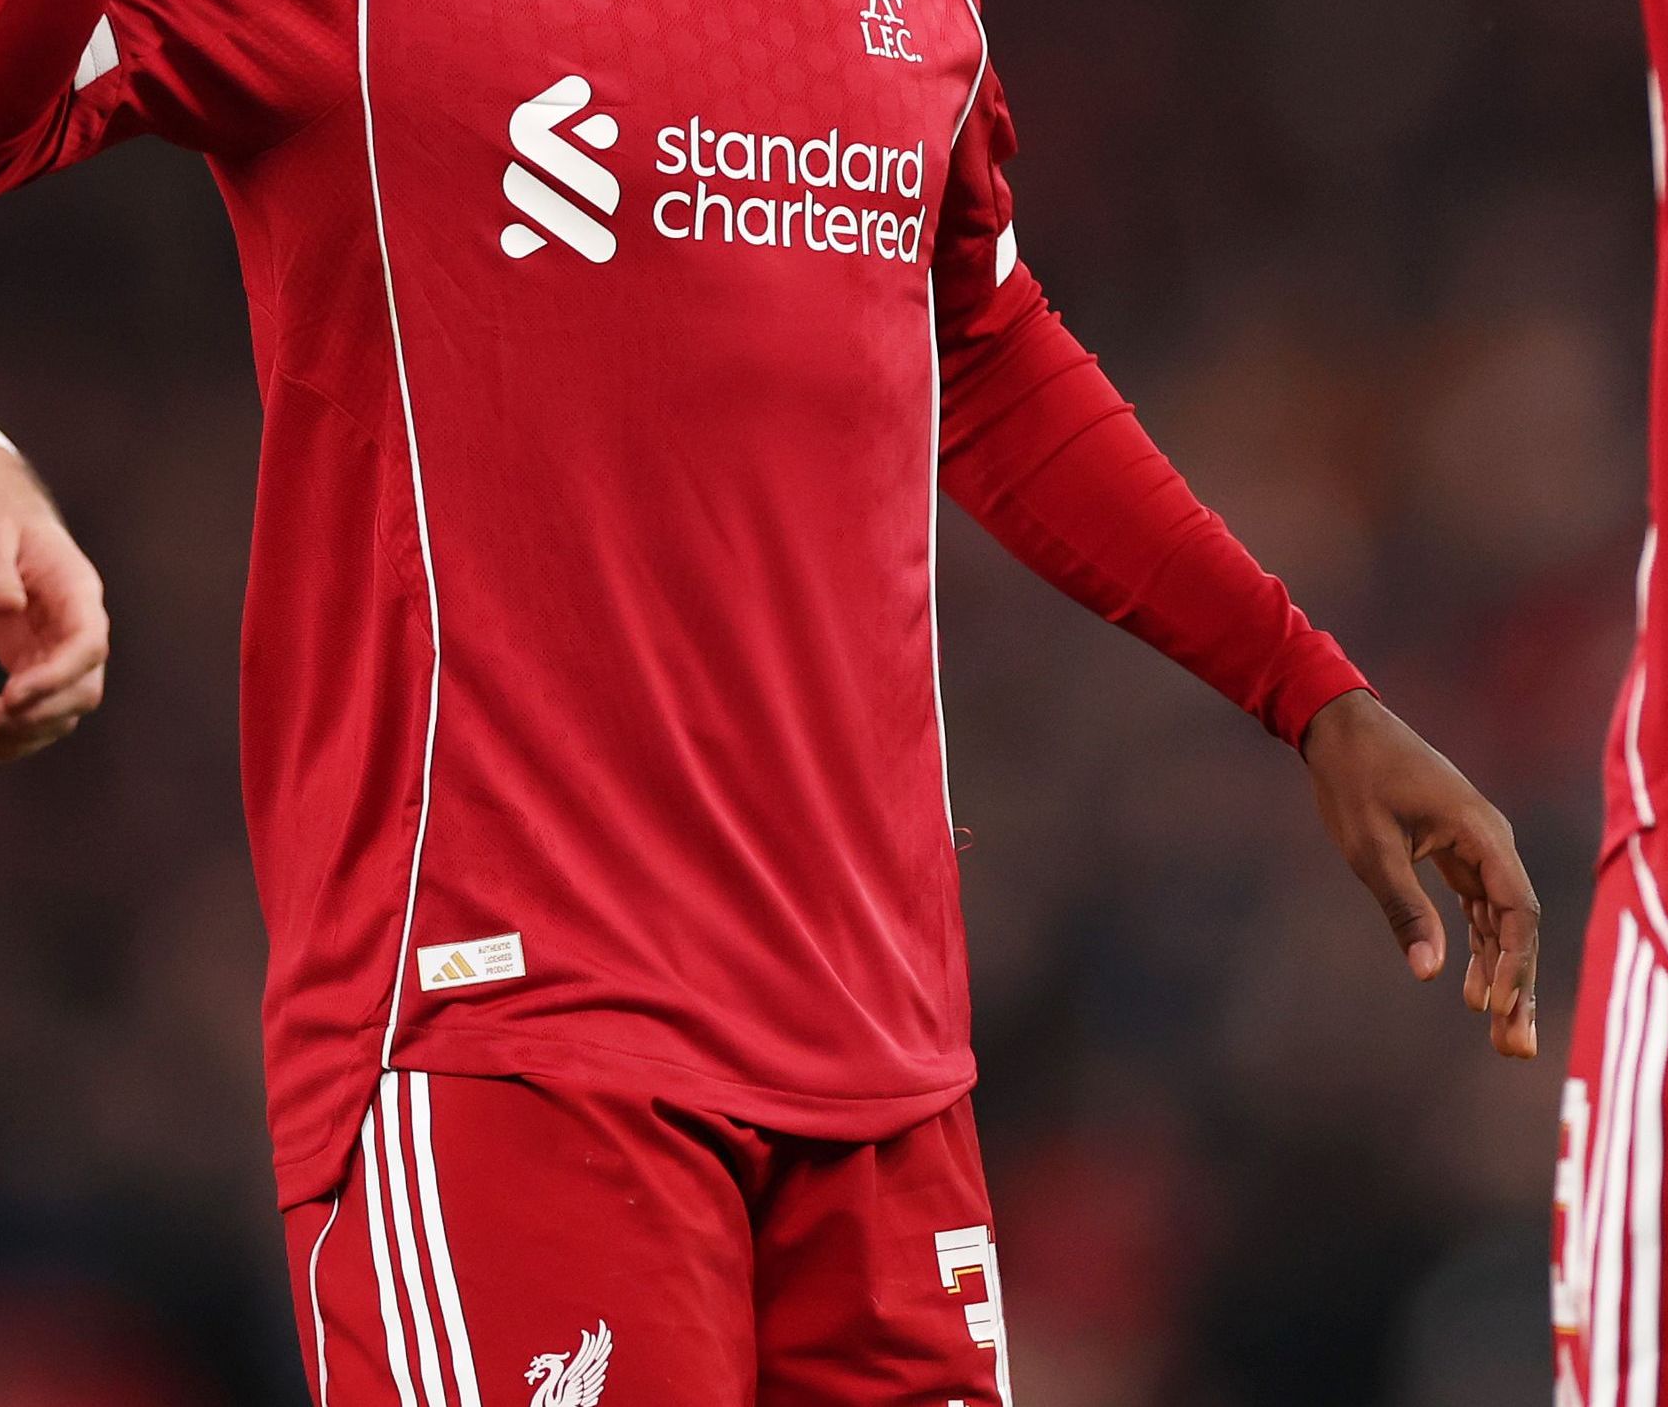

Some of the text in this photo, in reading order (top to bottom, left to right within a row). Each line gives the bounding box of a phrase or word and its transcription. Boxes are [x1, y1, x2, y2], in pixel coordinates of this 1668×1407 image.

[860, 21, 923, 63] L.F.C.
[655, 115, 924, 200] standard
[652, 180, 927, 264] chartered
